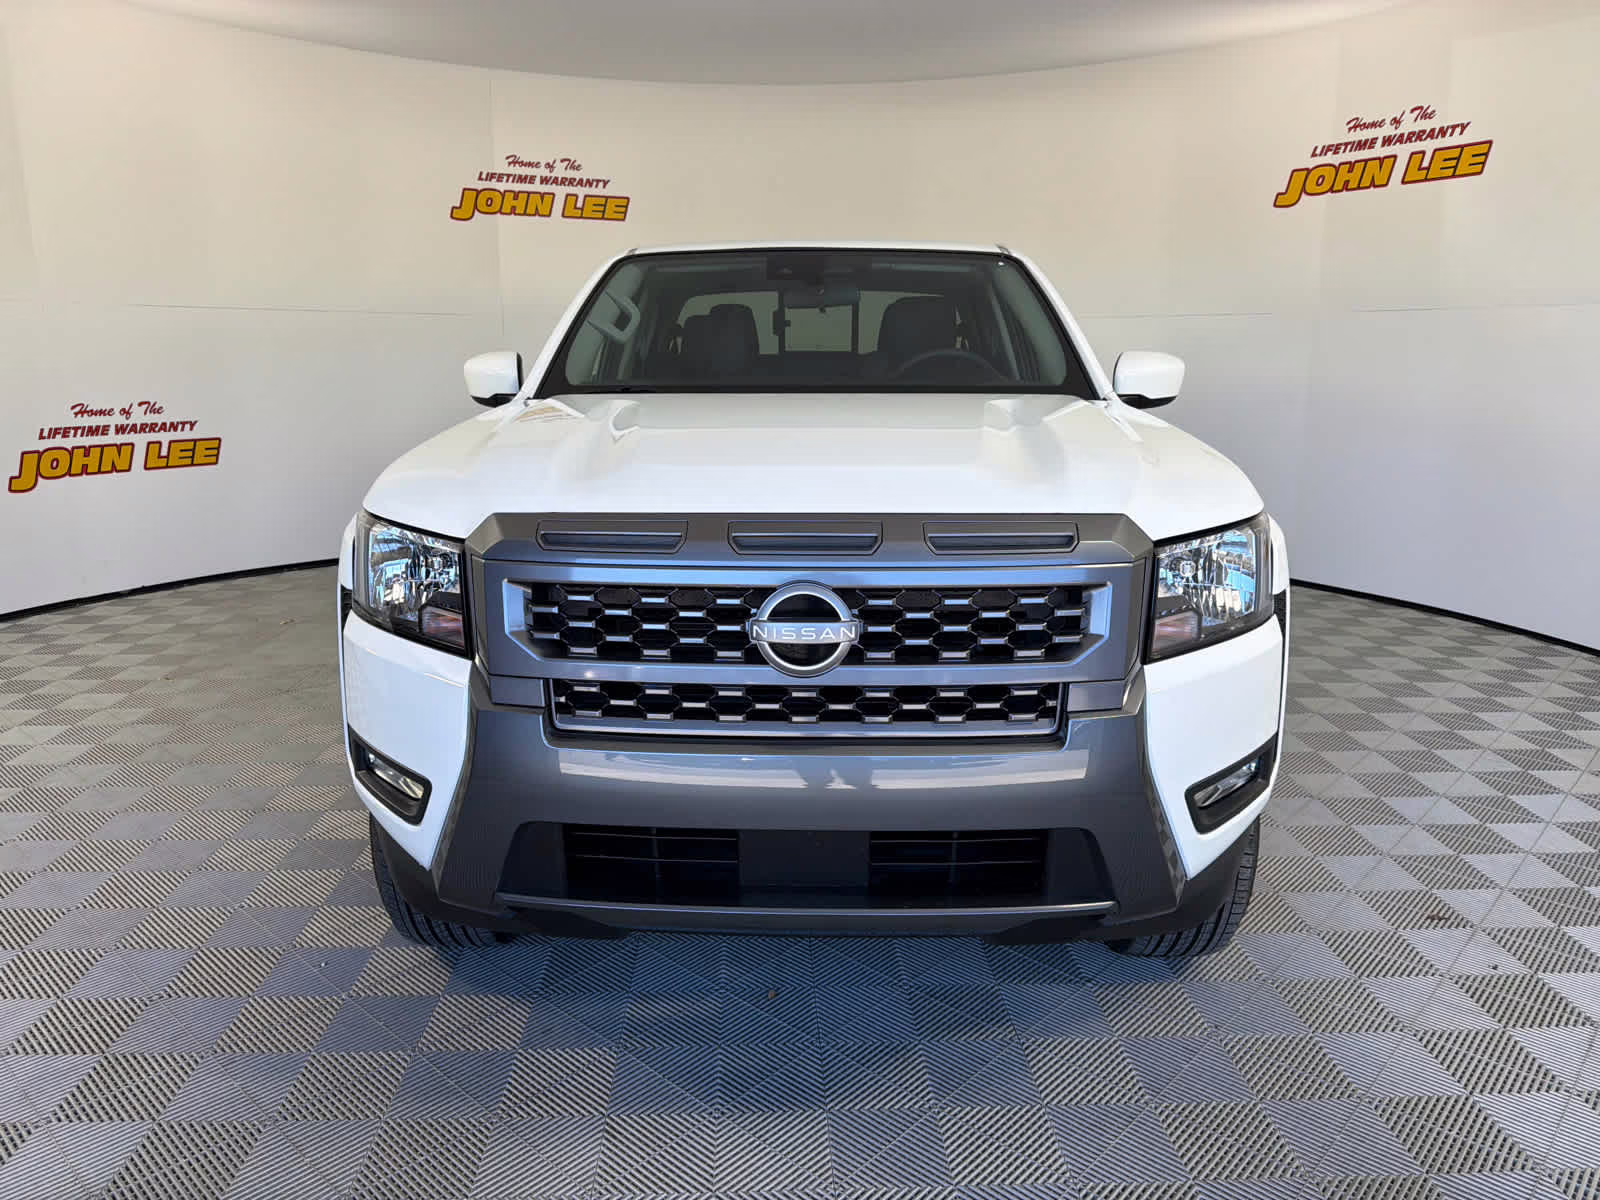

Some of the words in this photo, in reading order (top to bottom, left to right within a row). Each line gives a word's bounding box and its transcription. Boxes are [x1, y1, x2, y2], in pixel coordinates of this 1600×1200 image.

[1346, 117, 1386, 133] Home
[1390, 110, 1405, 129] of
[1410, 105, 1437, 123] The
[1310, 136, 1379, 158] LIFETIME
[1381, 121, 1472, 148] WARRANTY
[505, 154, 541, 169] Home
[544, 159, 556, 173] of
[560, 158, 583, 172] The
[1273, 154, 1397, 208] JOHN
[1401, 140, 1493, 185] LEE
[477, 171, 537, 185] LIFETIME
[539, 175, 611, 189] WARRANTY
[450, 188, 555, 221] JOHN
[562, 193, 630, 221] LEE
[70, 403, 115, 418] Home
[119, 403, 133, 420] of
[138, 401, 165, 416] The
[38, 424, 110, 440] LIFETIME
[115, 420, 198, 436] WARRANTY
[8, 442, 135, 493] JOHN
[144, 437, 221, 470] LEE
[753, 625, 856, 640] NISSAN
